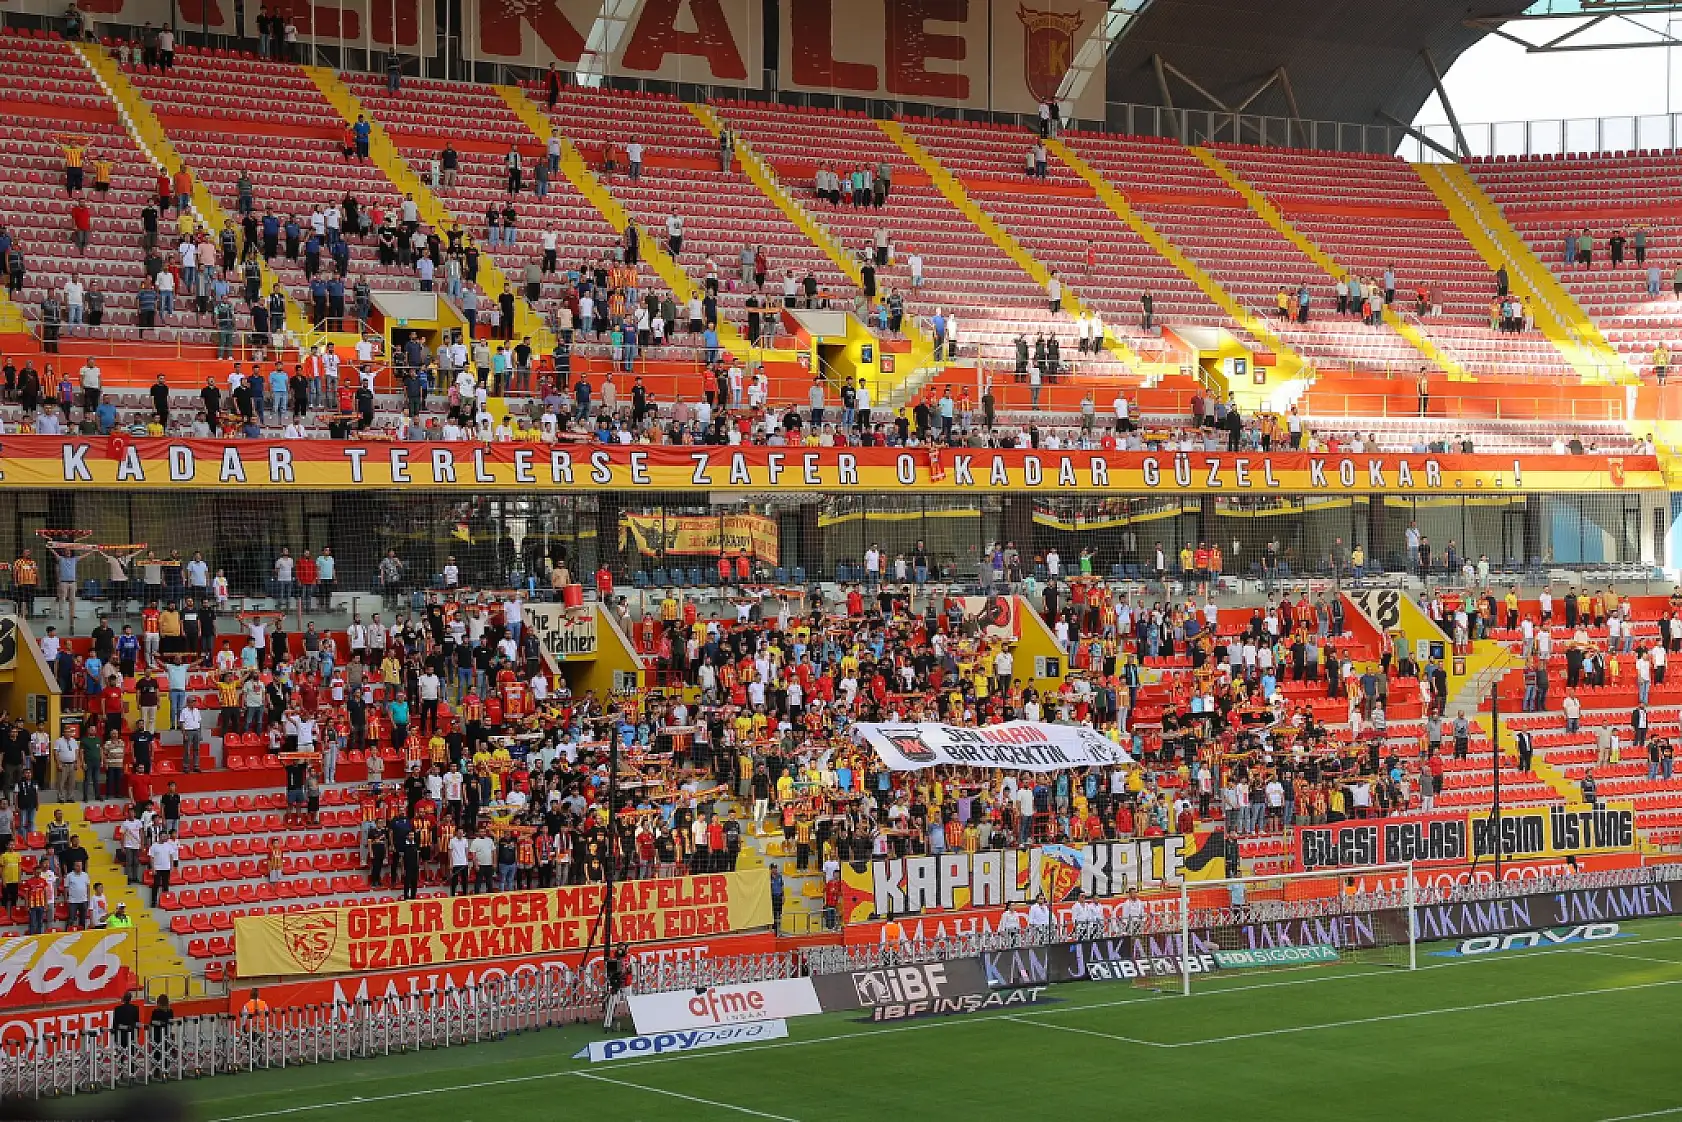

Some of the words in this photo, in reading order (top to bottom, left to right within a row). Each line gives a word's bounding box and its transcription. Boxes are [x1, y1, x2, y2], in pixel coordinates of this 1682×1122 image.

[62, 443, 295, 482] KADAR
[344, 449, 651, 485] TERLERSE
[690, 453, 859, 485] ZAFER
[897, 454, 916, 485] O
[954, 455, 1110, 486] KADAR
[1142, 452, 1281, 488] GÜZEL
[941, 727, 985, 743] SEN
[872, 846, 1042, 916] KAPALI
[1081, 836, 1186, 897] KALE
[1405, 898, 1531, 940] JAKAMEN
[1554, 885, 1673, 923] JAKAMEN
[348, 936, 433, 970] UZAK
[440, 926, 534, 961] YAKIN
[541, 920, 580, 950] NE
[663, 905, 730, 938] EDER
[688, 988, 765, 1022] afme
